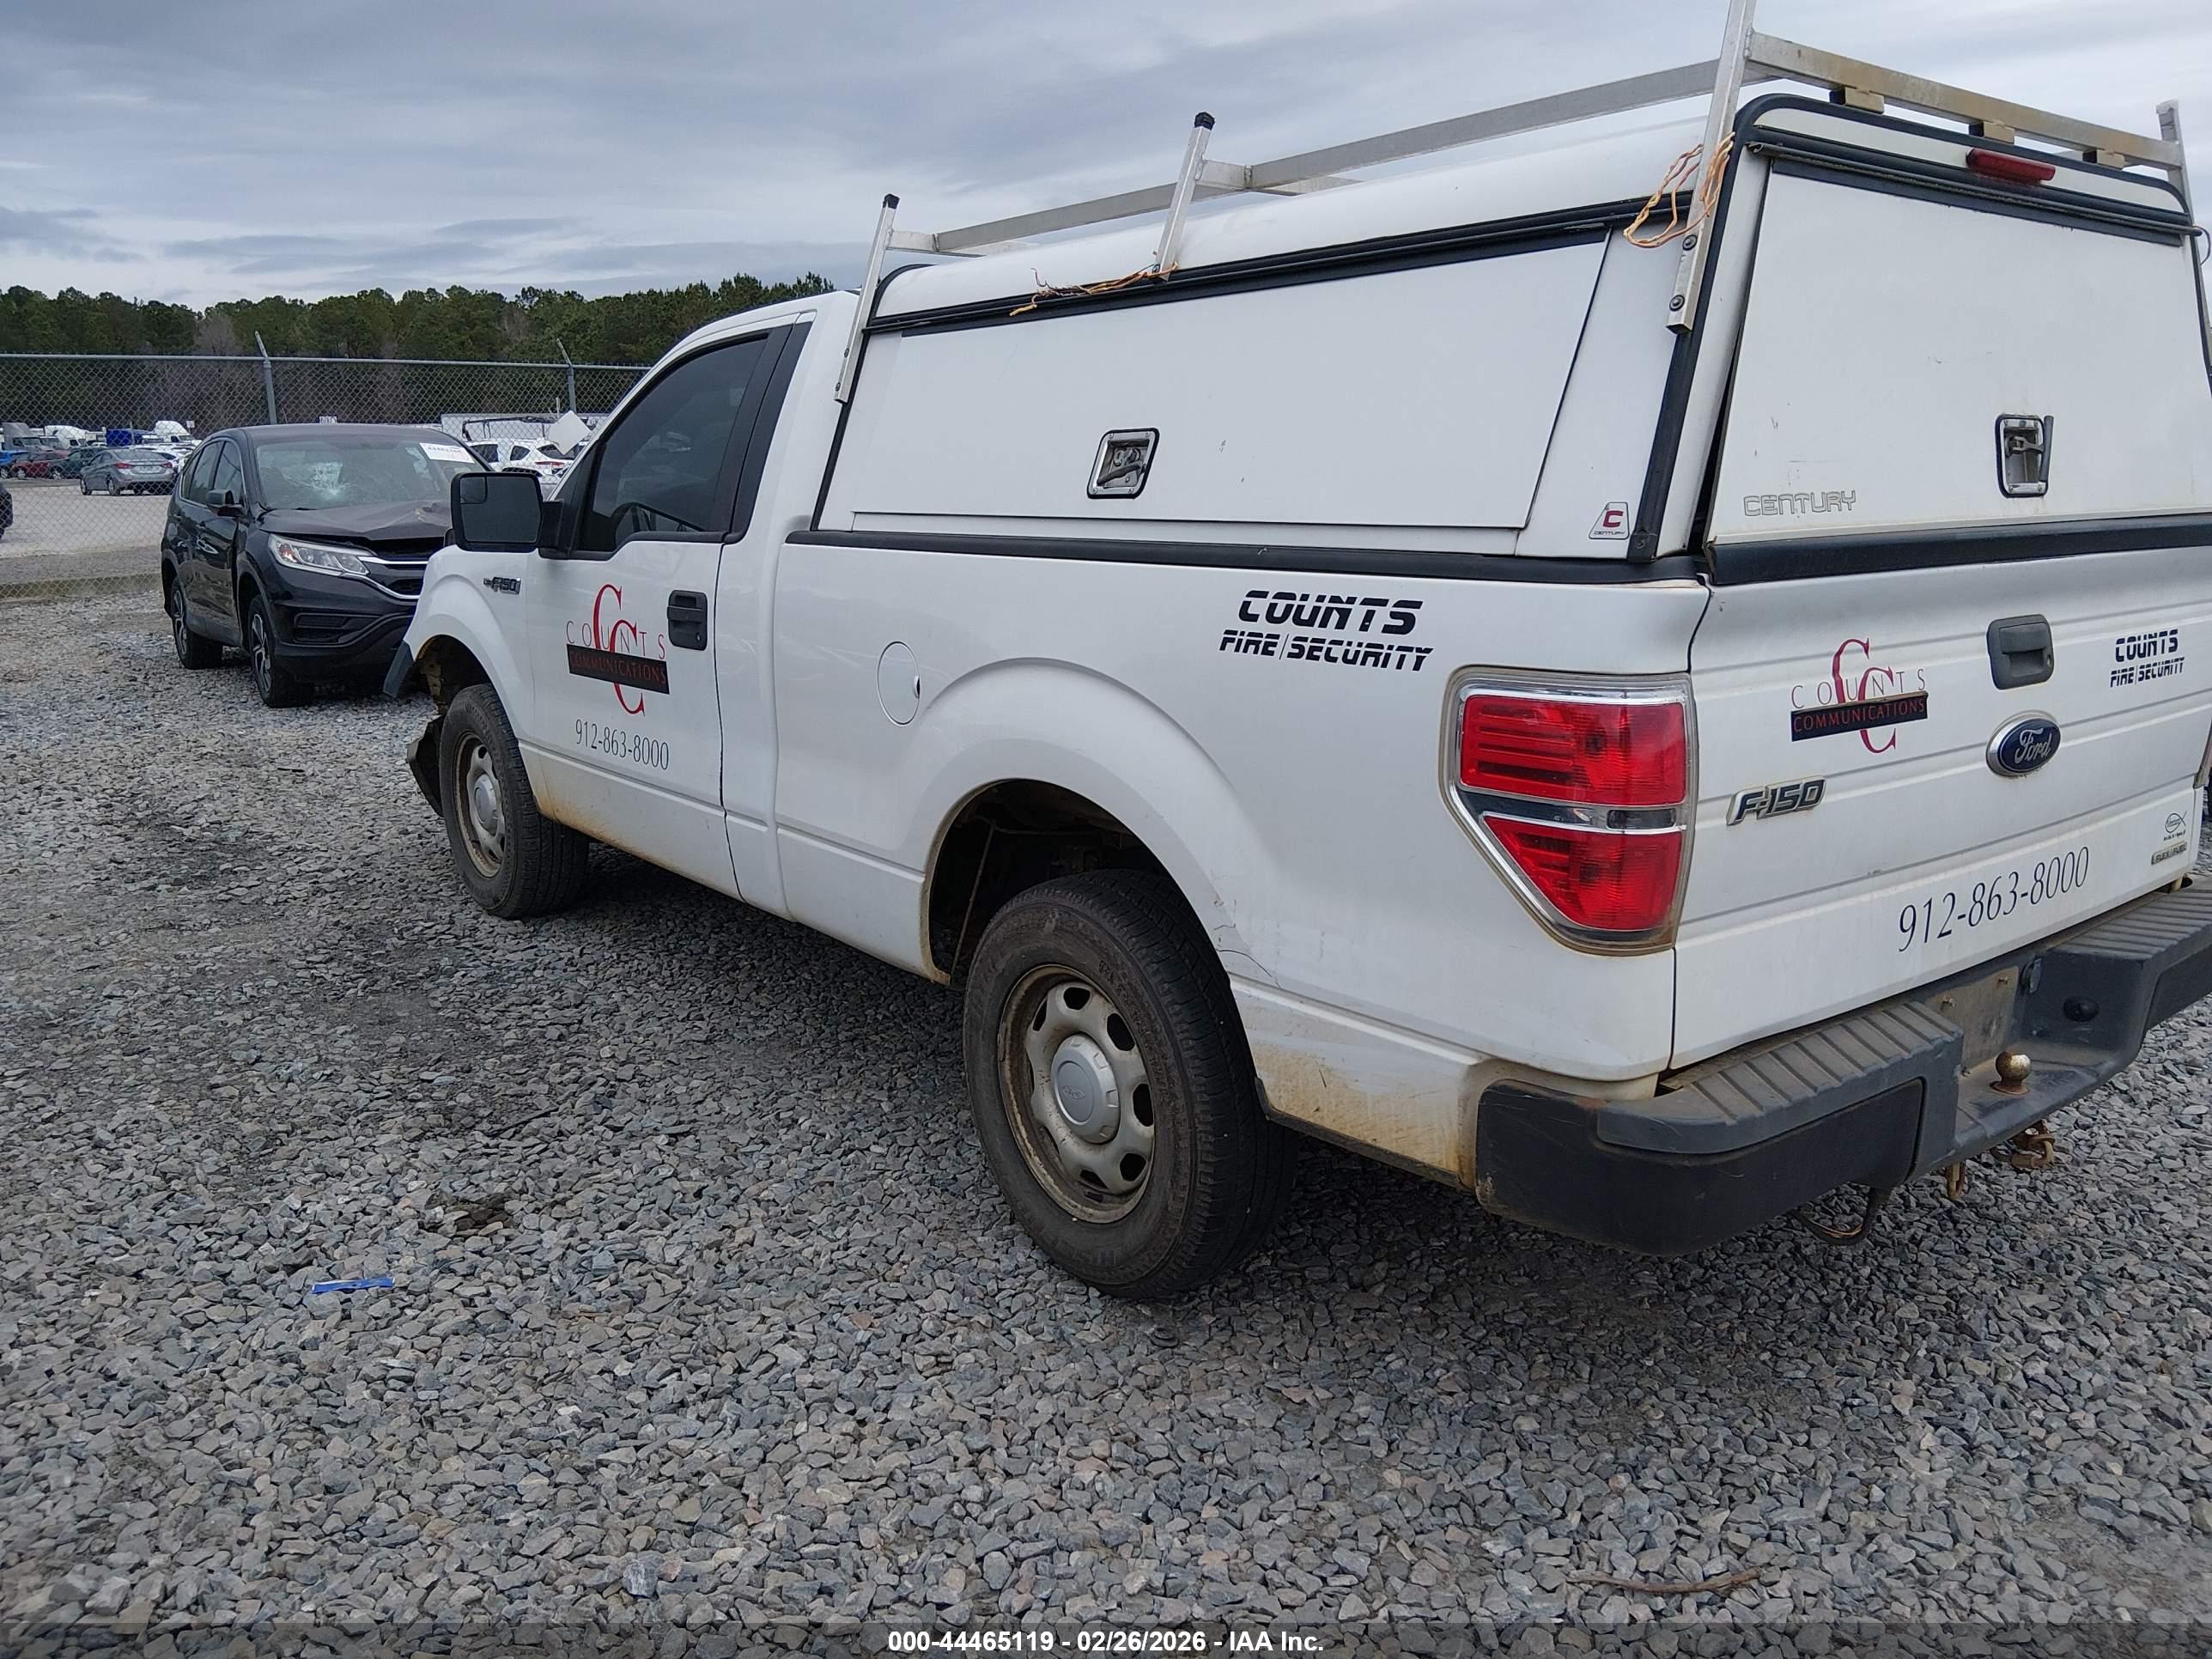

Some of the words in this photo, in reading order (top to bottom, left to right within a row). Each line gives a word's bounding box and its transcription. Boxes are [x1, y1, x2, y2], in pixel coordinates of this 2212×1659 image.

[1743, 490, 1856, 516] CENTURY
[1238, 590, 1424, 635] COUNTS
[566, 620, 665, 659] COUNTS
[2115, 629, 2179, 662] COUNTS
[568, 650, 666, 684] COMMUNICATIONS
[1791, 669, 1925, 709] COUNTS
[1794, 700, 1925, 732] COMMUNICATIONS
[575, 719, 670, 770] 912-863-8000
[2014, 727, 2052, 765] Ford
[1728, 776, 1826, 824] F-150
[1899, 846, 2089, 952] 912-863-8000
